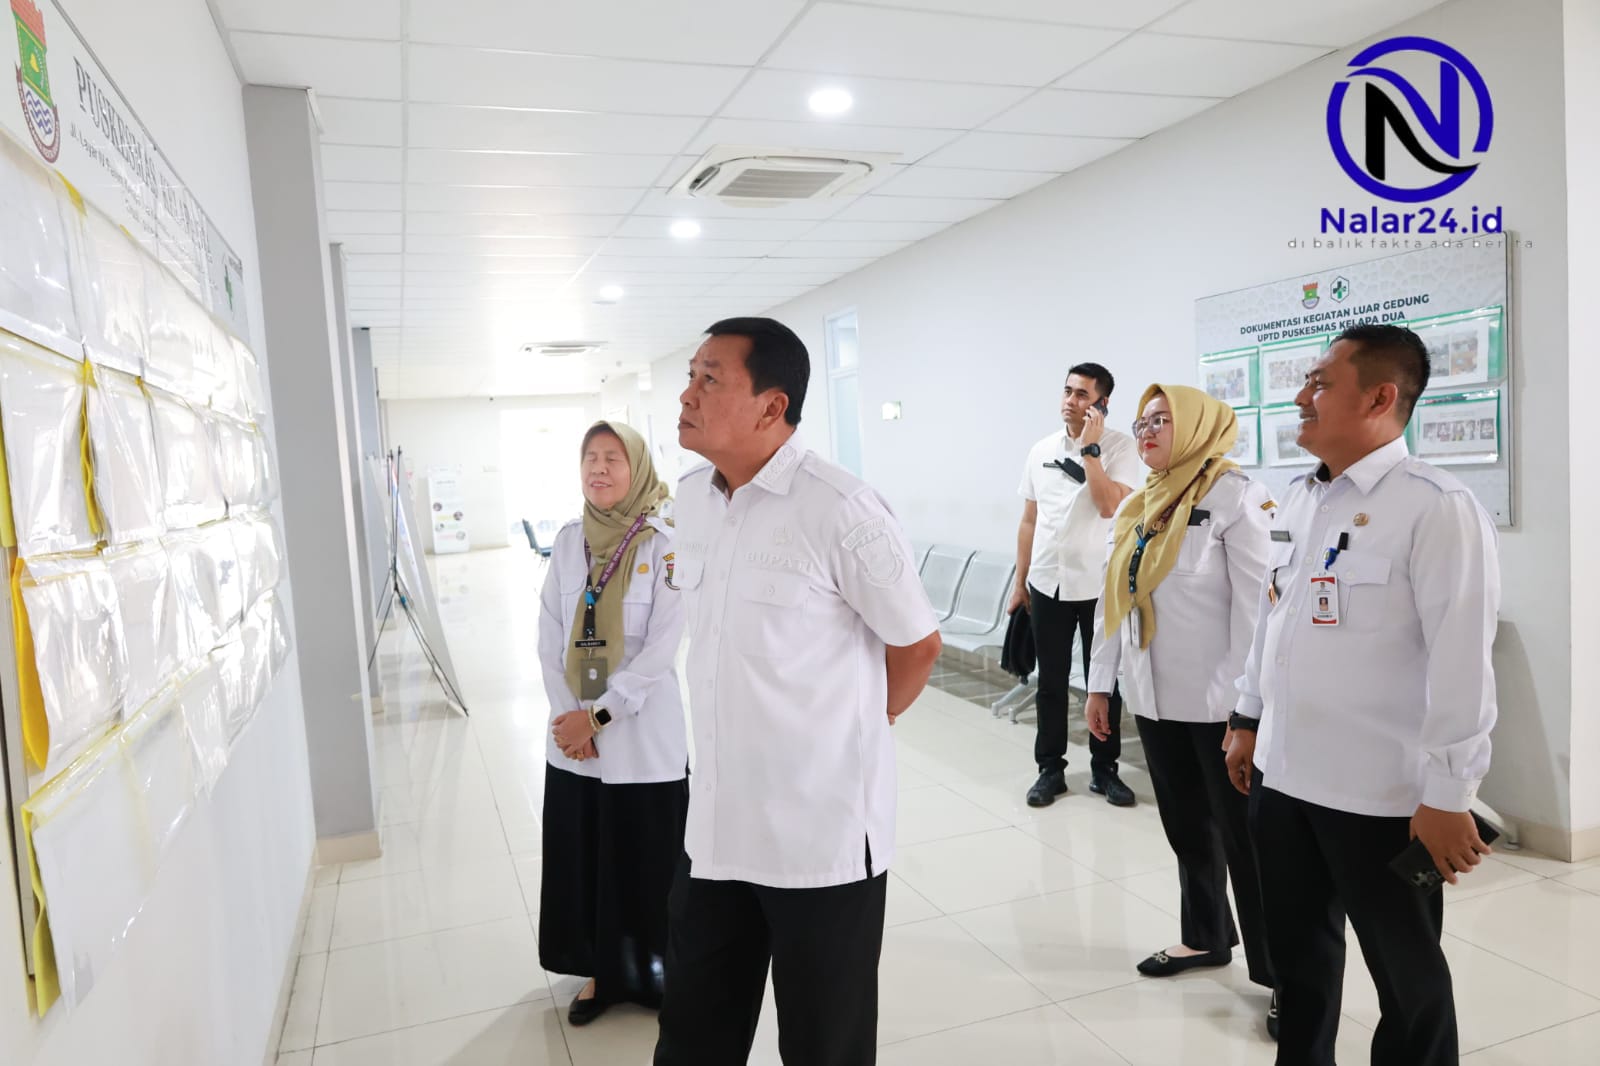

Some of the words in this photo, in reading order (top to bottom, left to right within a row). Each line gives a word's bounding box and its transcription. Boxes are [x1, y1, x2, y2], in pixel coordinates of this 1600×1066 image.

[1240, 317, 1301, 335] DOKUMENTASI
[1303, 308, 1350, 325] KEGIATAN
[1353, 303, 1380, 316] LUAR
[1383, 294, 1430, 311] GEDUNG
[1257, 332, 1280, 343] UPTD
[1282, 322, 1337, 341] PUSKESMAS
[1382, 311, 1406, 323] DUA
